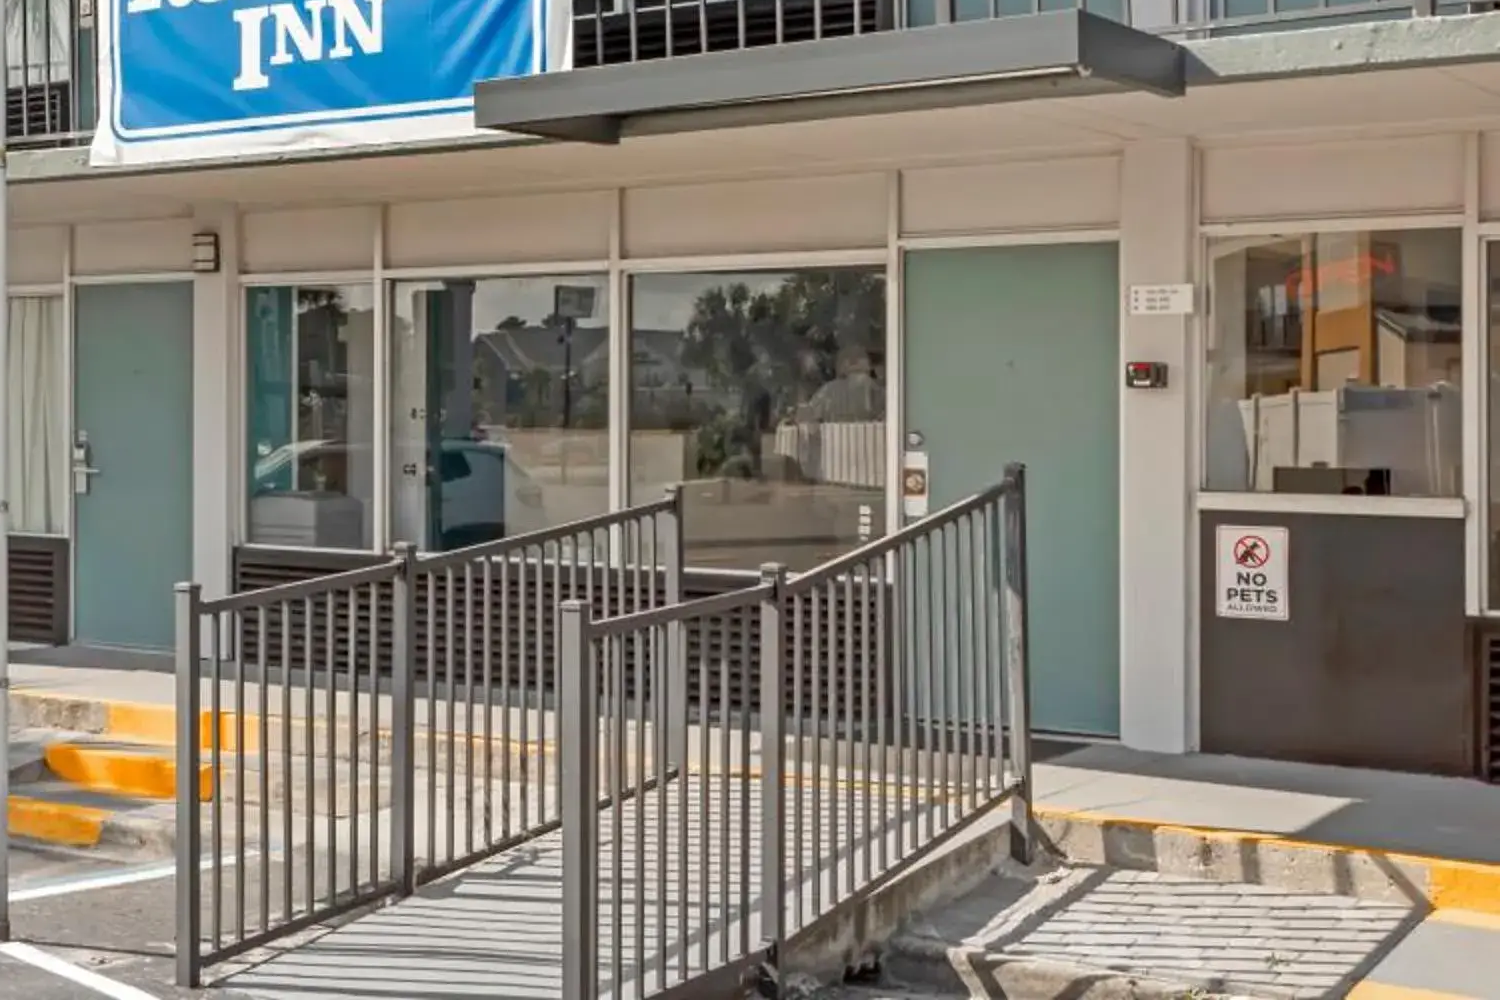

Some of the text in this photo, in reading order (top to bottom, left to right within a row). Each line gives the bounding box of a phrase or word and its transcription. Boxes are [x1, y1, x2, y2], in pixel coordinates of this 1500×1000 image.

[1236, 571, 1268, 587] NO
[1226, 588, 1279, 604] PETS
[1226, 603, 1278, 613] ALLOWED
